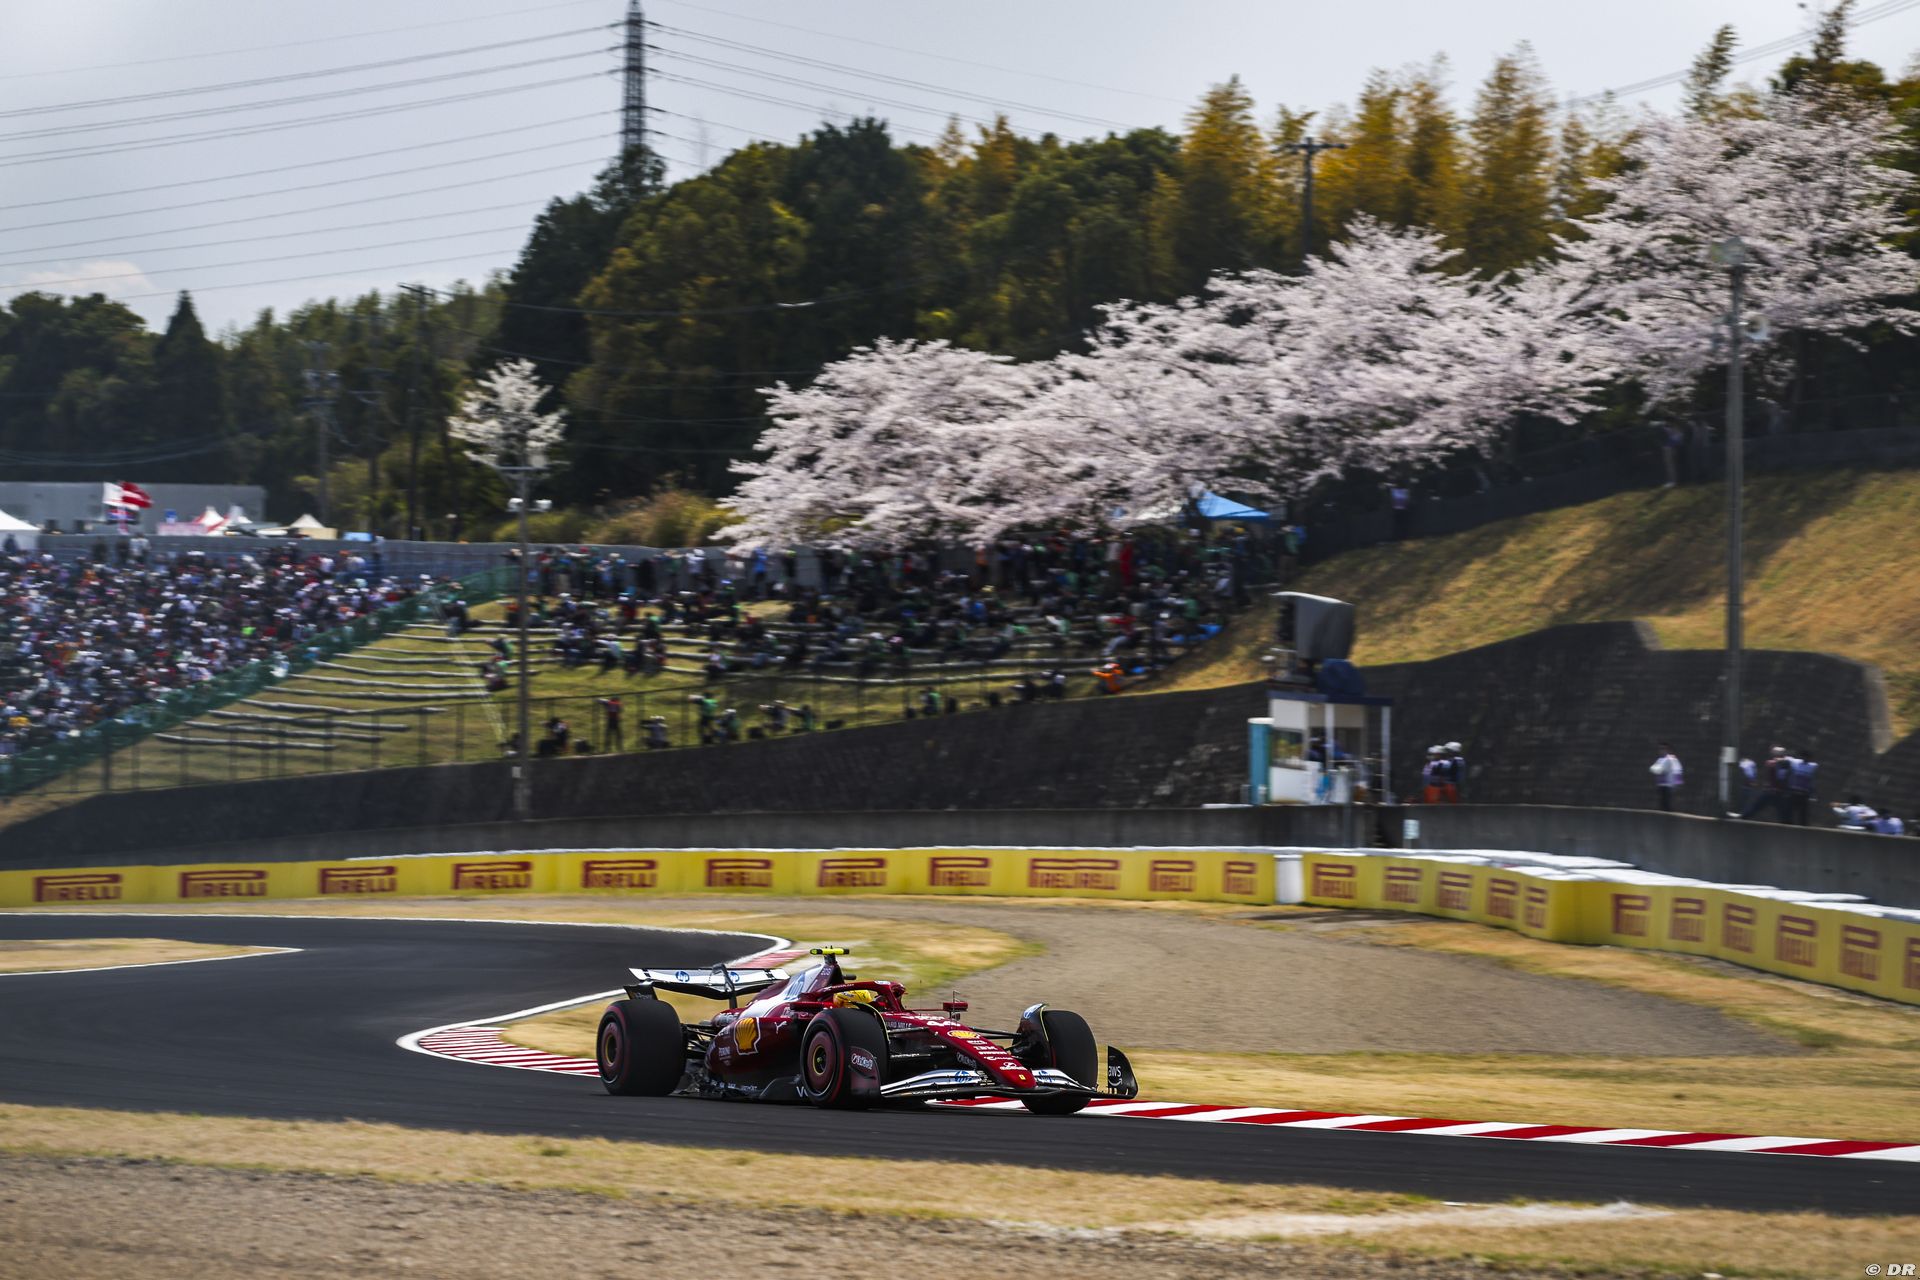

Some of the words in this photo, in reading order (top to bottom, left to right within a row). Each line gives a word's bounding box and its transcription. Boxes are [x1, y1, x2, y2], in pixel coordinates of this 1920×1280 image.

[179, 870, 267, 898] PIRELLI
[319, 867, 396, 895] PIRELLI
[452, 861, 532, 890] PIRELLI
[582, 860, 657, 889] PIRELLI
[706, 858, 772, 887] PIRELLI
[818, 858, 886, 887] PIRELLI
[930, 857, 991, 887] PIRELLI
[34, 873, 122, 902] PIRELLI
[676, 970, 690, 982] hp
